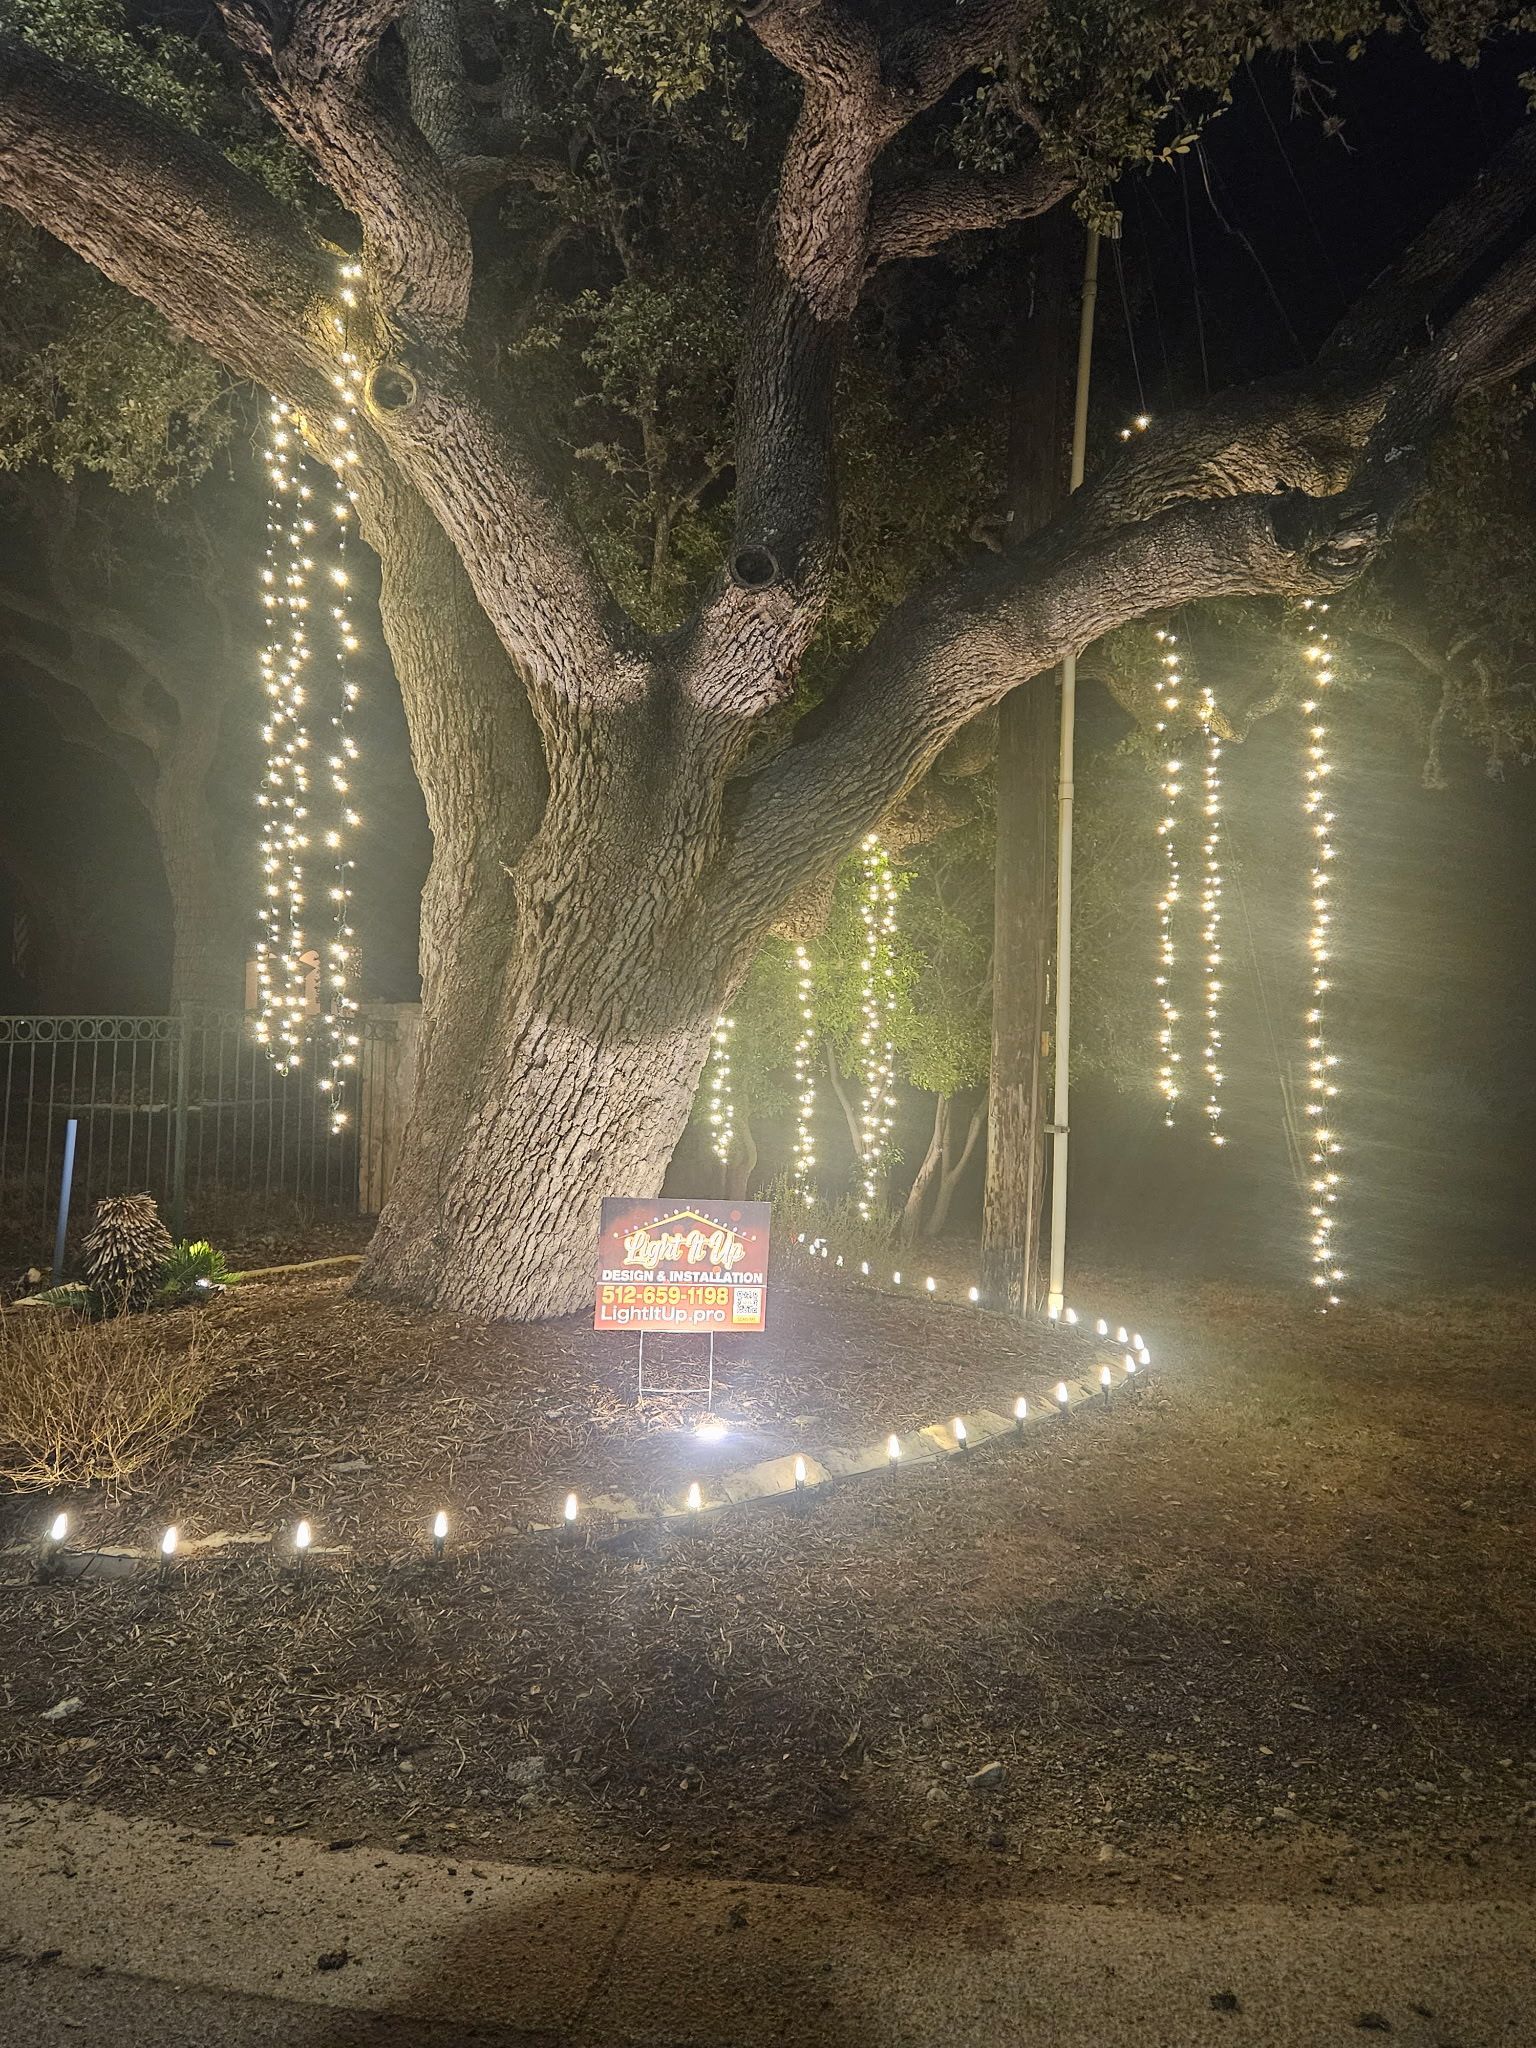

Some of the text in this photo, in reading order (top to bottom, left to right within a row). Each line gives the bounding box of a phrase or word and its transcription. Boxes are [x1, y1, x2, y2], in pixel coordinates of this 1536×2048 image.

[623, 1229, 746, 1270] Light It Up
[602, 1270, 763, 1284] DESIGN & INSTALLATION
[602, 1286, 729, 1305] 512-659-1198
[601, 1305, 726, 1323] LightItUp.pro
